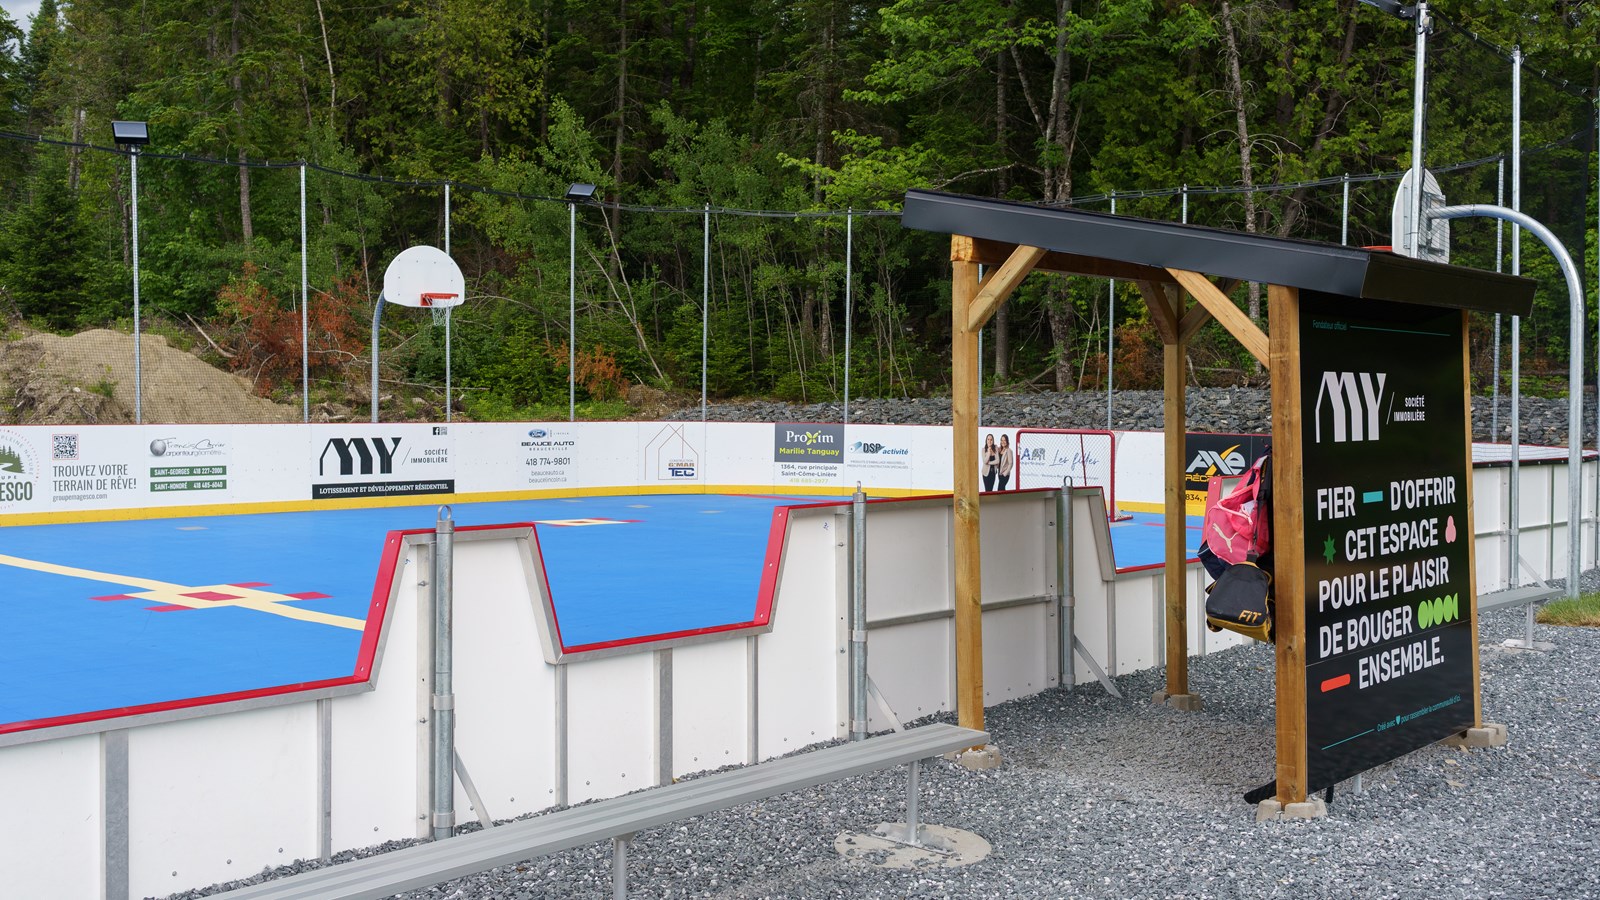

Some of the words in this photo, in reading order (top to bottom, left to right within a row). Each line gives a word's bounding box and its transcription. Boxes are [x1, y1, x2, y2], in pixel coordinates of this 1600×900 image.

[1315, 371, 1387, 443] MY
[1404, 395, 1425, 408] SOCIÉTÉ
[1393, 409, 1426, 422] IMMOBILIÈRE
[319, 436, 402, 476] MY
[424, 448, 448, 456] SOCIÉTÉ
[806, 448, 840, 457] Tanguay
[863, 443, 886, 454] DSP
[882, 448, 909, 456] activité
[410, 456, 448, 464] IMMOBILIÈRE
[525, 458, 538, 466] 418
[540, 457, 571, 466] 774-9801
[1049, 449, 1069, 466] Les
[53, 465, 96, 477] TROUVEZ
[99, 464, 128, 476] VOTRE
[154, 468, 190, 476] SAINT-GEORGES
[668, 467, 695, 477] TEC
[53, 479, 93, 492] TERRAIN
[96, 479, 108, 491] DE
[110, 475, 137, 490] RÊVE!
[154, 482, 188, 490] SAINT-HONORÉ
[367, 484, 415, 492] DÉVELOPPEMENT
[414, 483, 449, 491] RÉSIDENTIEL
[53, 493, 108, 502] groupemagesco.com
[1317, 485, 1356, 521] FIER
[1390, 476, 1456, 511] D'OFFRIR
[1345, 526, 1377, 562] CET
[1380, 517, 1439, 555] ESPACE
[1318, 572, 1367, 613] POUR
[1370, 567, 1390, 600] LE
[1392, 556, 1449, 594] PLAISIR
[1319, 621, 1343, 659] DE
[1347, 604, 1413, 651] BOUGER
[1358, 635, 1445, 690] ENSEMBLE.
[1386, 719, 1396, 729] avec
[1401, 714, 1409, 724] pour
[1409, 706, 1429, 720] rassembler
